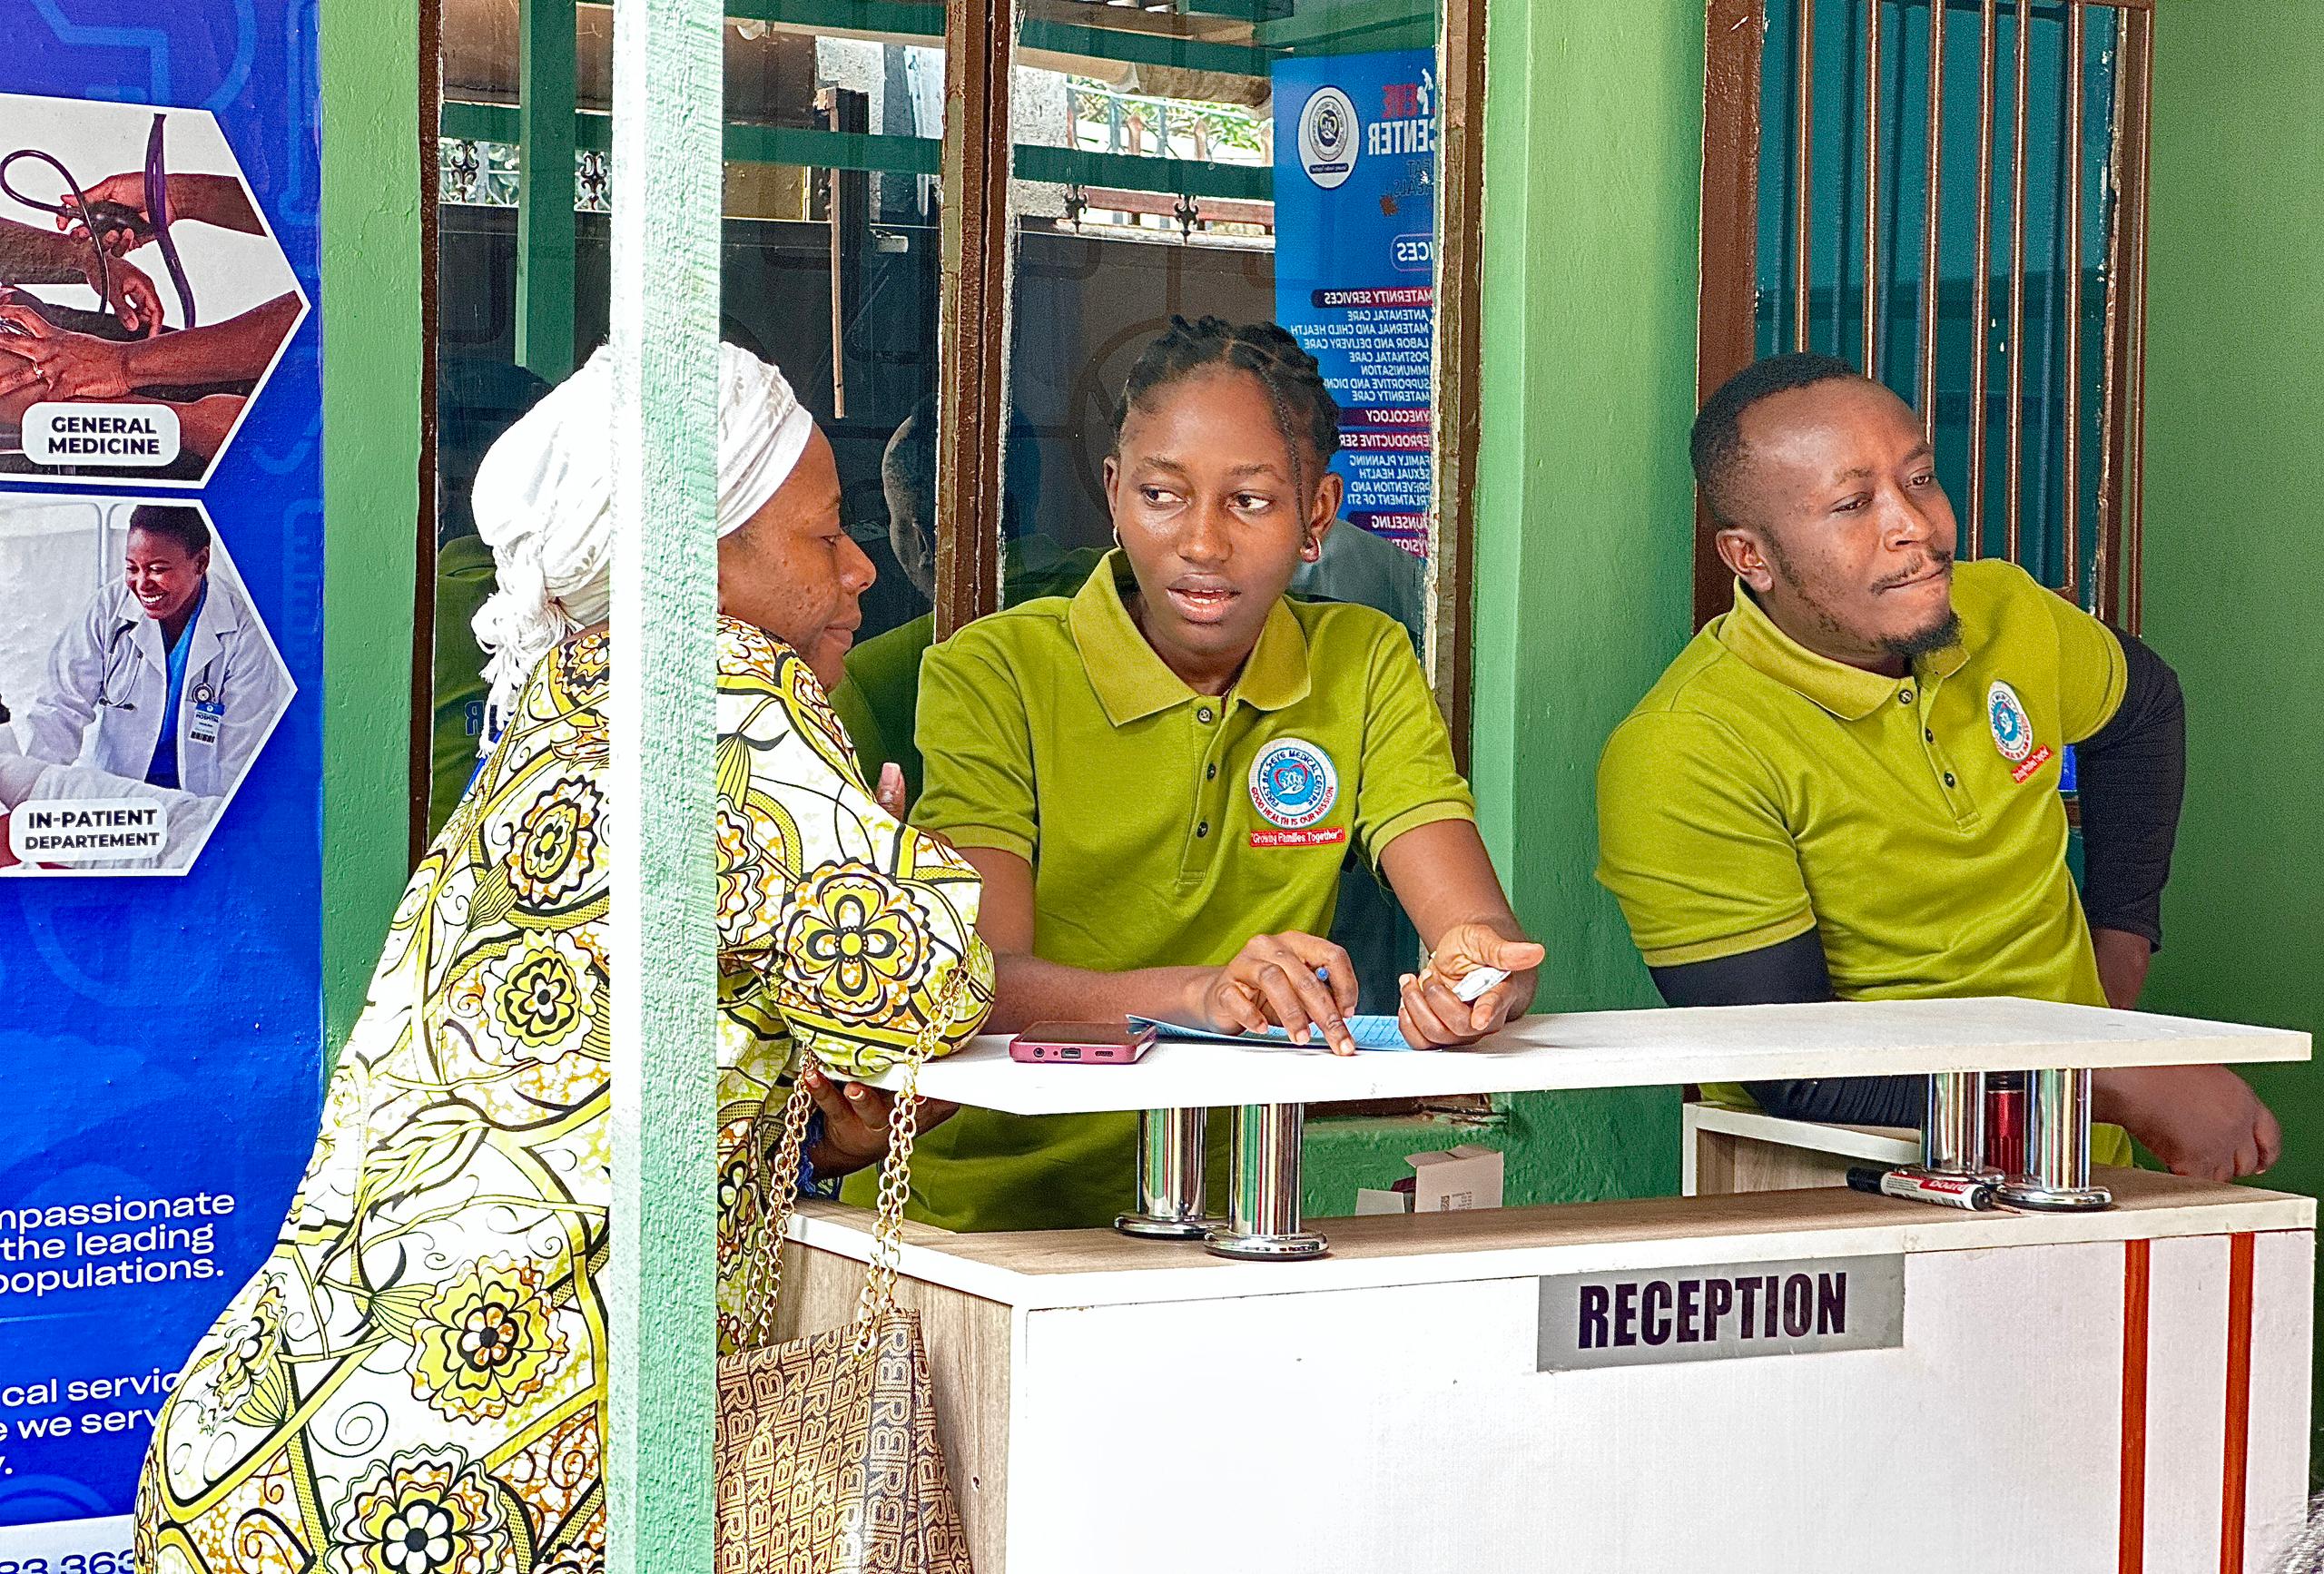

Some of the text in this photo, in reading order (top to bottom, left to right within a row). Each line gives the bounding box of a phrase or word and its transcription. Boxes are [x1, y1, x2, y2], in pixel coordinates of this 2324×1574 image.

[51, 416, 158, 437] GENERAL
[47, 436, 161, 457] MEDICINE
[28, 809, 158, 830] IN-PATIENT
[25, 832, 161, 851] DEPARTEMENT
[0, 1223, 214, 1261] the leading
[1578, 1272, 1847, 1349] RECEPTION
[16, 1416, 72, 1440] we
